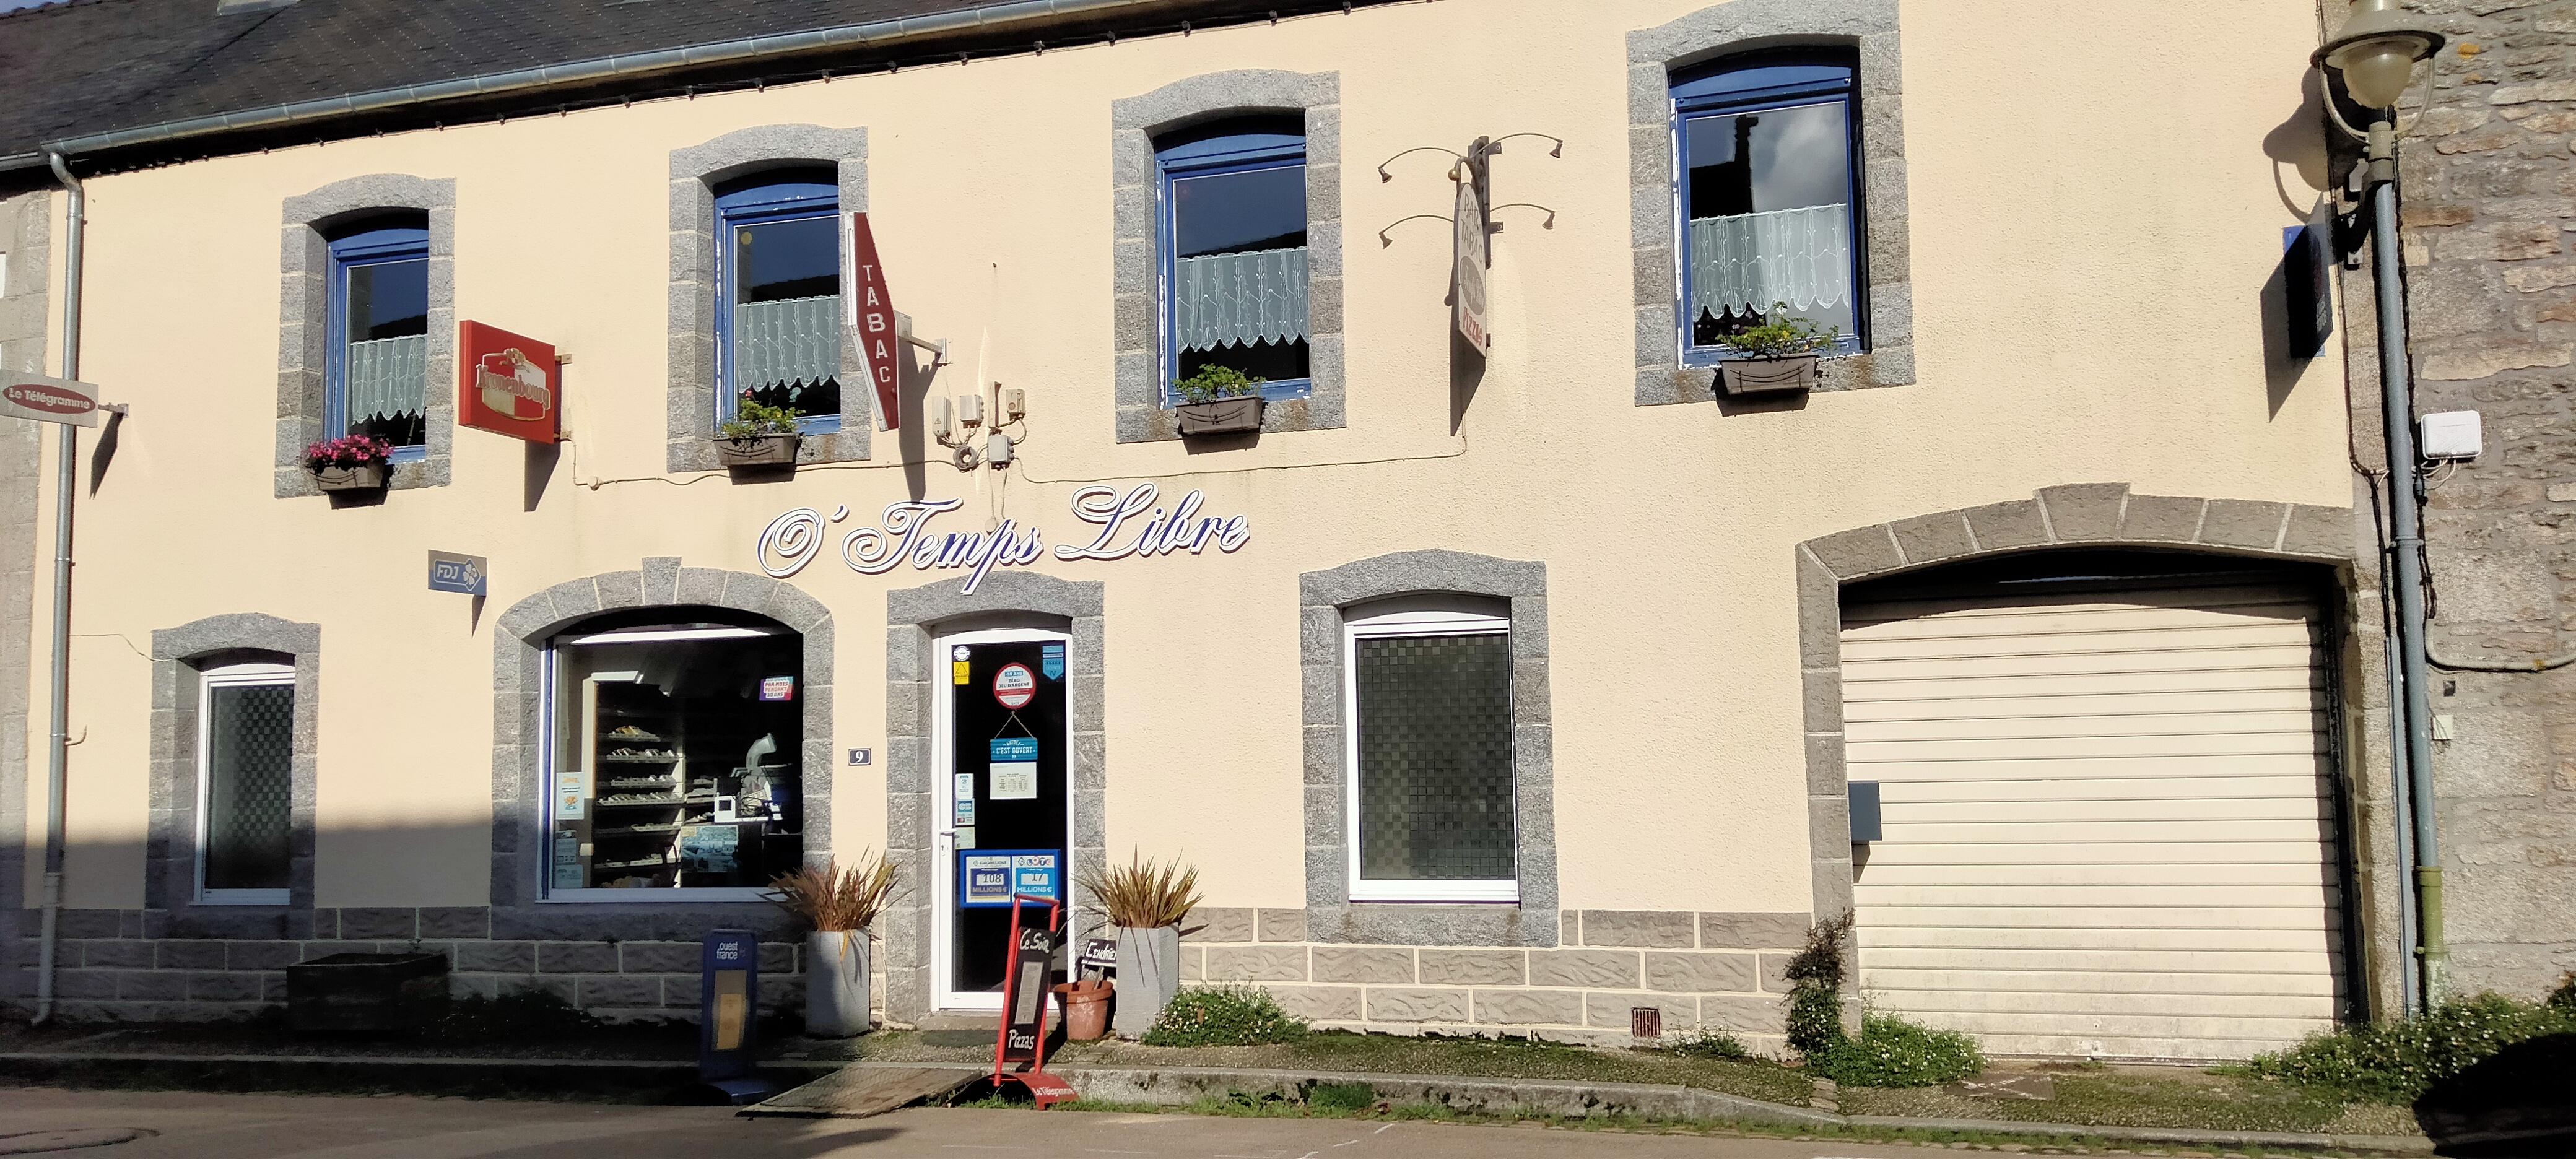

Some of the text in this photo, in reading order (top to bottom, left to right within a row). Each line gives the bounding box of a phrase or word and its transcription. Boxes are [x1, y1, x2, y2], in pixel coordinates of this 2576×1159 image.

[1464, 191, 1479, 230] BAR
[1461, 218, 1483, 264] TABAC
[863, 264, 891, 383] TABAC
[476, 364, 551, 410] Kronenbourg
[9, 388, 91, 409] Le Télégramme
[1054, 482, 1251, 562] Libre
[437, 564, 459, 580] FDJ
[855, 750, 863, 763] 9
[1012, 746, 1033, 754] OUVERT
[983, 874, 1001, 883] 108
[1032, 873, 1044, 882] 17
[716, 948, 738, 960] france
[719, 941, 738, 951] ouest
[1009, 1028, 1035, 1050] Pizzas
[1032, 1087, 1042, 1096] Le
